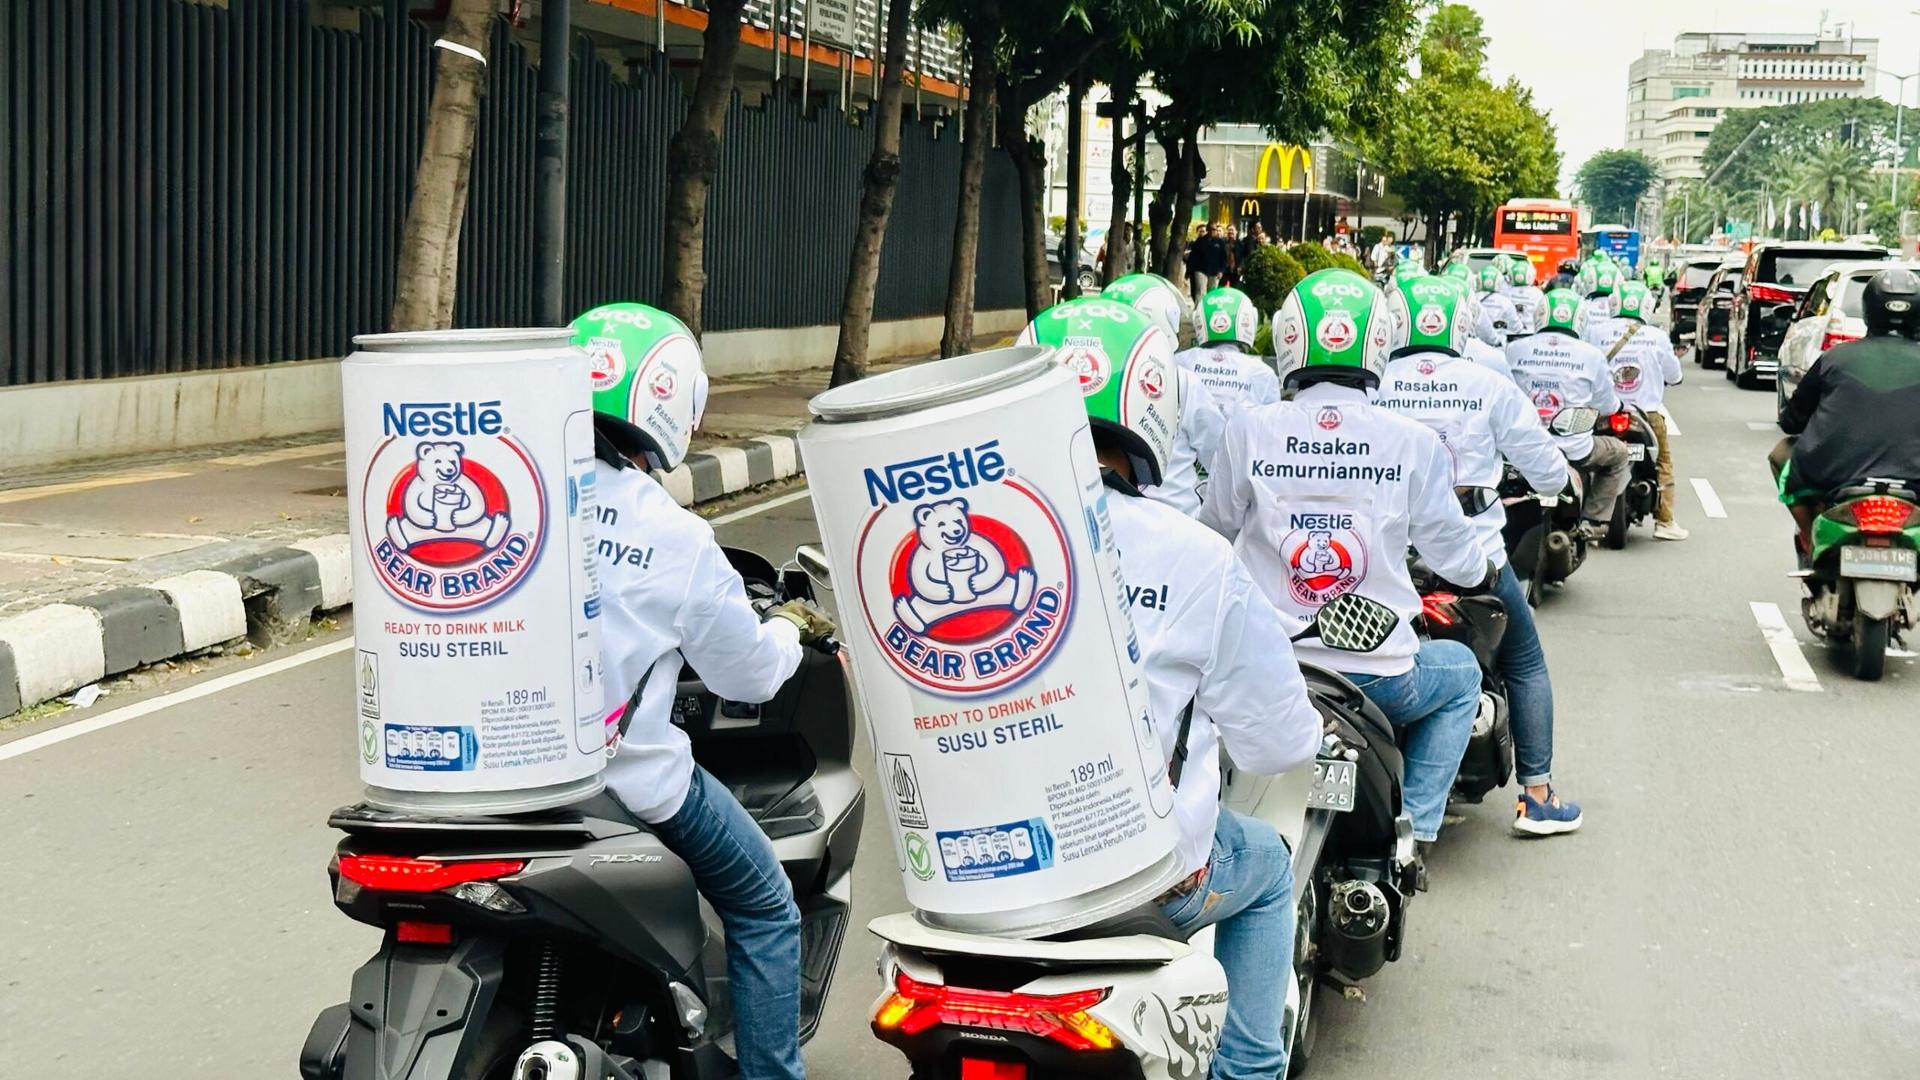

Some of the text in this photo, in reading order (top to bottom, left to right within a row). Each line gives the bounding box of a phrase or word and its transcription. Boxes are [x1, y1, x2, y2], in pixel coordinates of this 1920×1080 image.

[1312, 281, 1364, 298] Grab
[586, 308, 652, 329] Grab
[1051, 303, 1129, 323] Grab
[1194, 363, 1238, 376] Rasakan
[1394, 379, 1458, 393] Rasakan
[383, 400, 502, 438] Nestlé
[1286, 436, 1370, 455] Rasakan
[864, 439, 1006, 508] Nestlé
[1252, 460, 1401, 485] Kemurniannya!
[375, 539, 434, 595] BEAR
[442, 535, 529, 598] BRAND
[384, 619, 525, 635] READY TO DRINK MILK
[885, 589, 1061, 679] BEAR BRAND
[399, 640, 509, 658] SUSU STERIL
[506, 689, 529, 706] 189
[532, 685, 546, 703] ml
[913, 683, 1076, 731] READY TO DRINK MILK
[937, 713, 1064, 754] SUSU STERIL
[1070, 762, 1095, 784] 189
[1098, 753, 1114, 775] ml
[960, 1031, 1009, 1042] HONDA
